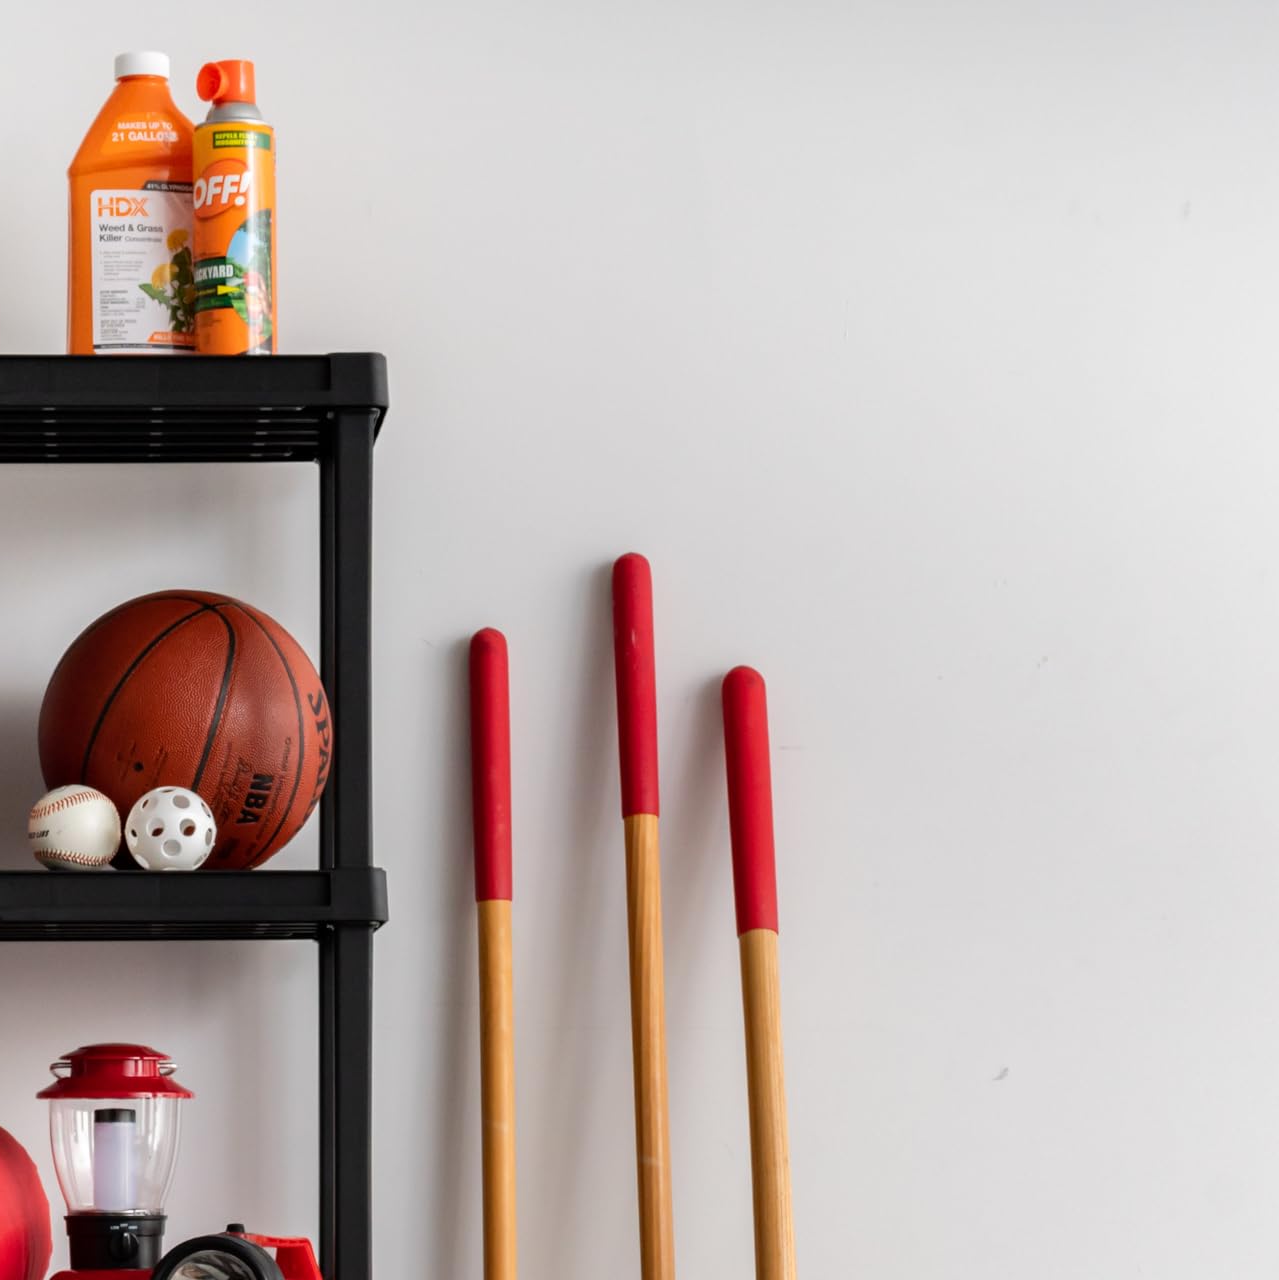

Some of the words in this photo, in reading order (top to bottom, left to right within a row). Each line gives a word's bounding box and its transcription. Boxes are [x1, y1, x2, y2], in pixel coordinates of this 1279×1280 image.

[112, 132, 125, 142] 21
[193, 171, 252, 209] OFF!
[97, 197, 149, 217] HDX
[99, 224, 125, 232] Weed
[128, 224, 134, 232] &
[137, 224, 163, 232] Grass
[99, 234, 122, 242] Killer
[236, 773, 274, 825] NBA
